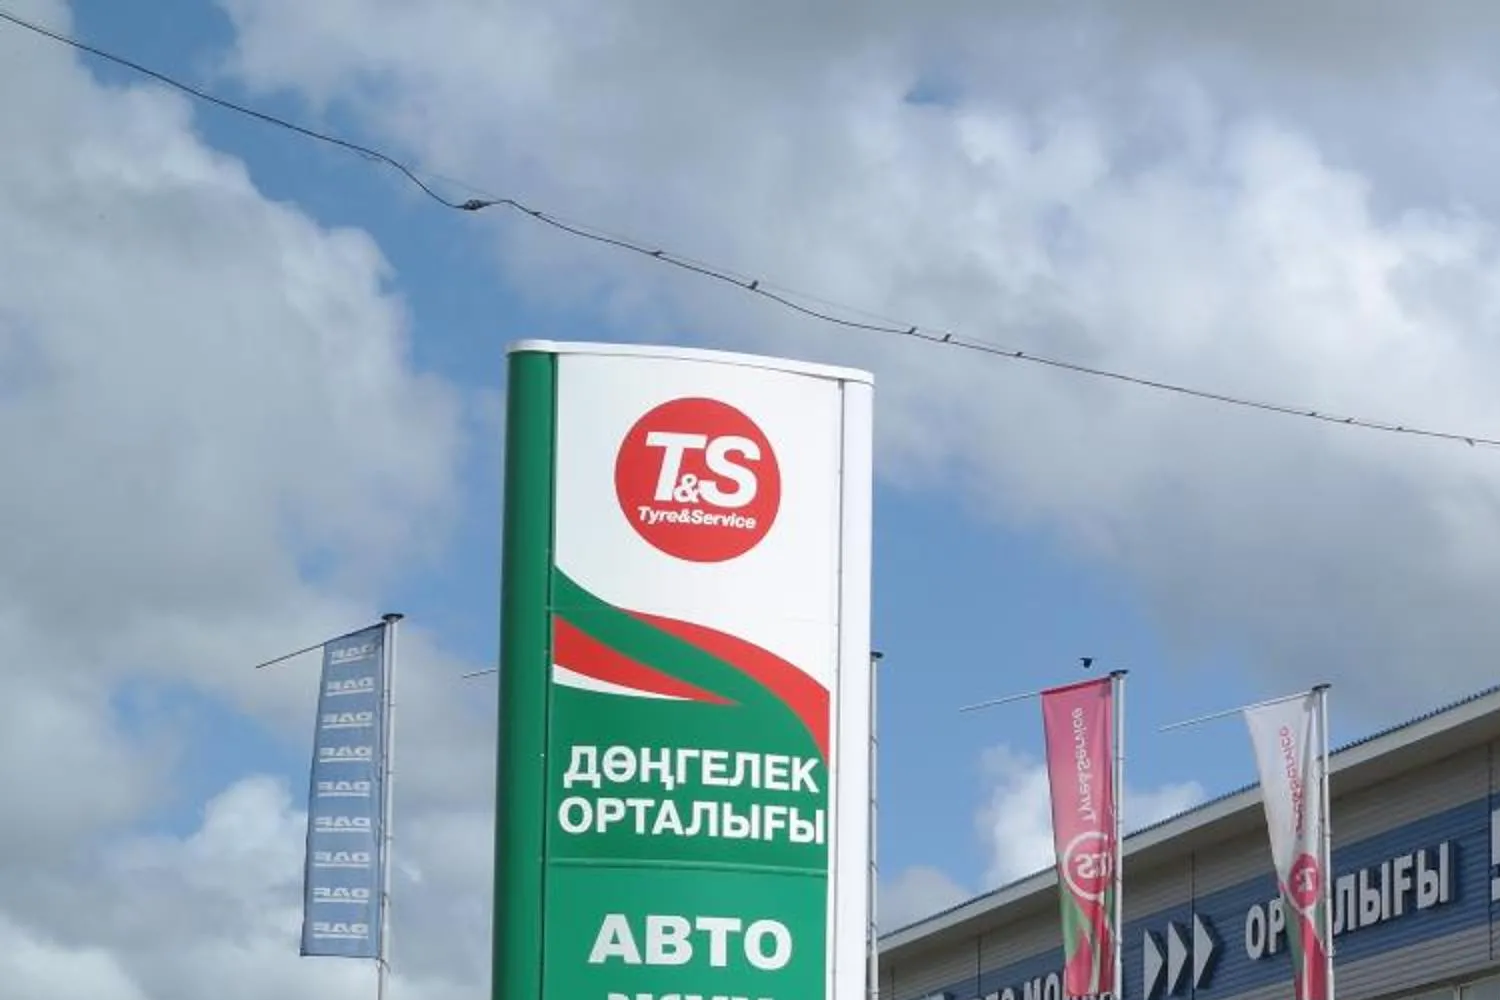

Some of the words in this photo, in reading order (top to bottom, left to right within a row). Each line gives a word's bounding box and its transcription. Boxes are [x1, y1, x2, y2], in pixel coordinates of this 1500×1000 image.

[645, 431, 761, 508] T&S
[637, 506, 757, 529] Tyre&Service
[563, 745, 820, 792] ДӨҢГЕЛЕК
[1245, 842, 1449, 960] ОРЛЫҒЫ
[588, 914, 793, 970] АВТО
